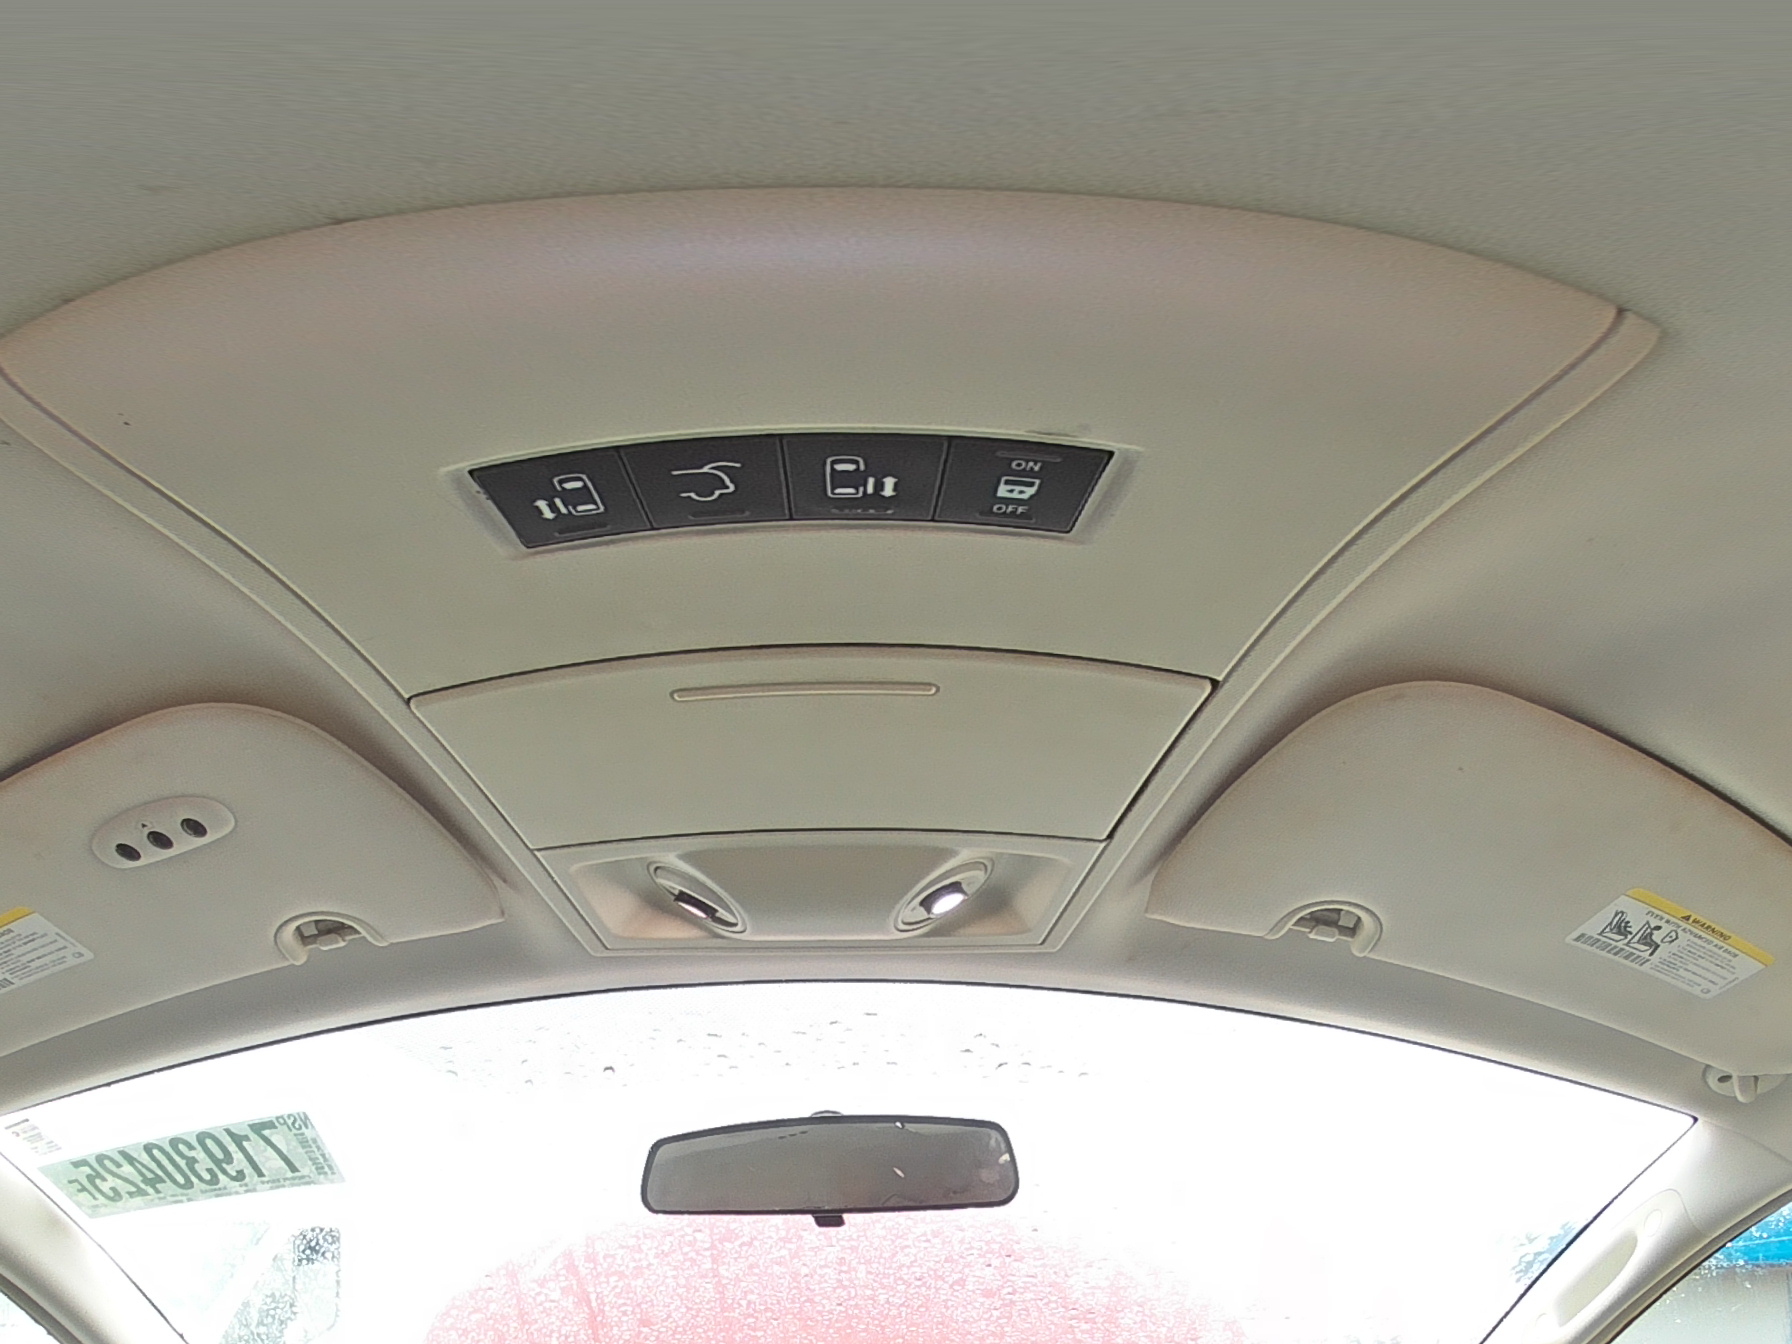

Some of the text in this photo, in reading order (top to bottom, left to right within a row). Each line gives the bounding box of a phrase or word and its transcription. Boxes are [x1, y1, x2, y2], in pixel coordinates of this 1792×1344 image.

[1010, 459, 1042, 472] ON
[992, 503, 1029, 515] OFF
[1691, 917, 1733, 941] WARNING
